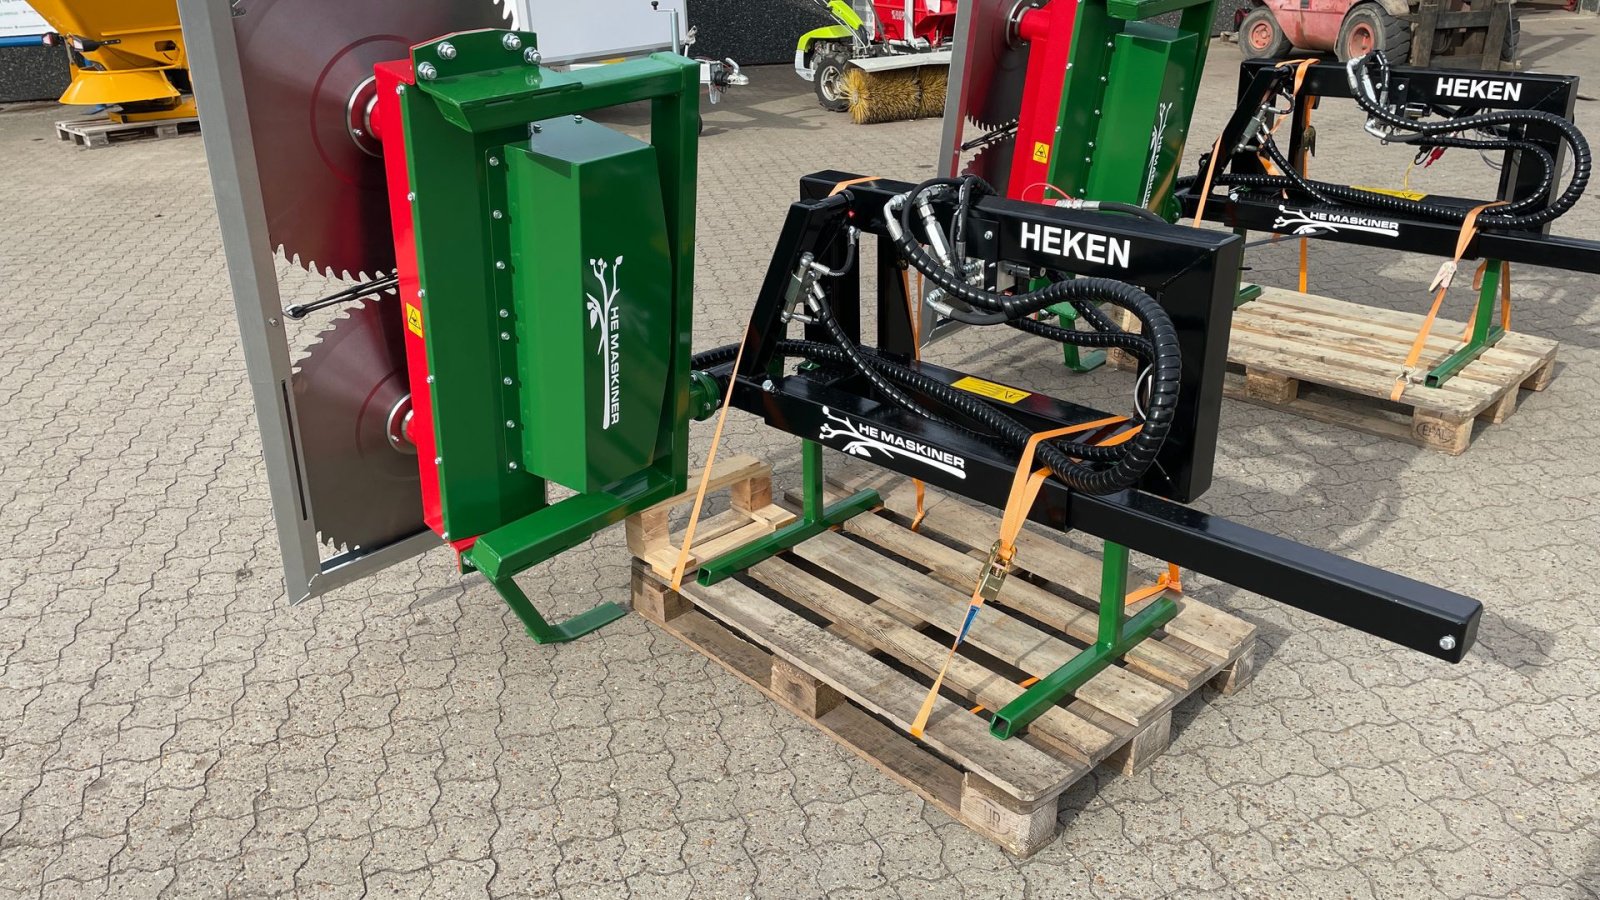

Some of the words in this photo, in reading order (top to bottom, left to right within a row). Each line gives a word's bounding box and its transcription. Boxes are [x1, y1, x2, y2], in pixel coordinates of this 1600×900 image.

[1435, 77, 1522, 101] HEKEN
[1309, 211, 1327, 221] HE
[1328, 214, 1399, 230] MASKINER
[1020, 221, 1131, 269] HEKEN
[610, 306, 619, 331] HE
[610, 333, 620, 425] MASKINER
[858, 422, 879, 439] HE
[881, 431, 965, 469] MASKINER
